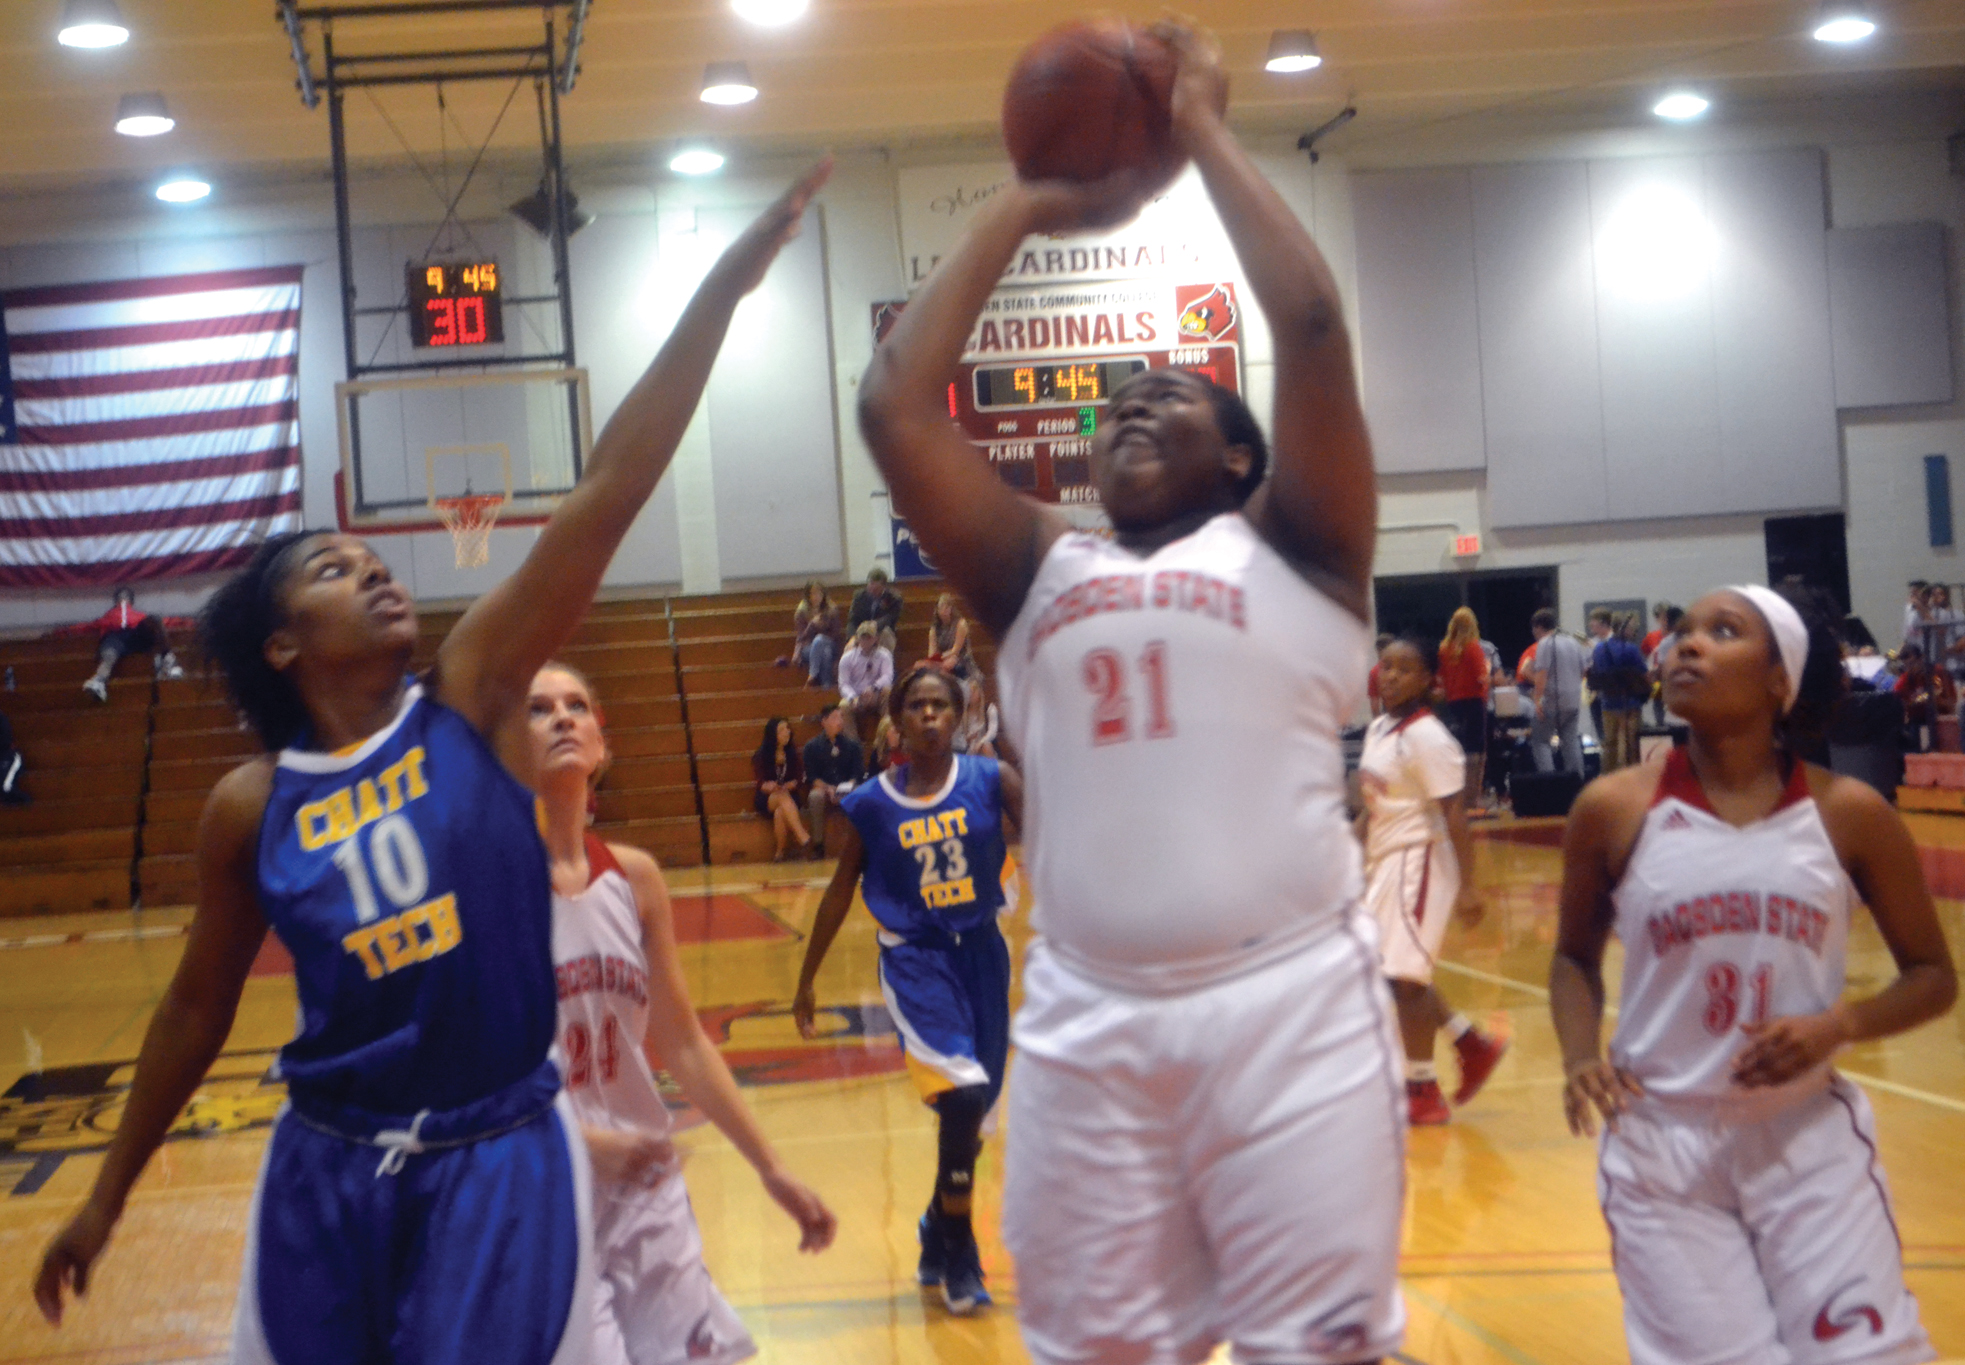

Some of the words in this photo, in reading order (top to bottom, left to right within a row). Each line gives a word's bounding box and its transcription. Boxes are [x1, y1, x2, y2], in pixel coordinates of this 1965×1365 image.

[426, 296, 487, 346] 30
[966, 311, 1157, 354] ARDINALS
[1168, 348, 1209, 366] BONUS
[1036, 418, 1077, 435] PERIOD
[1078, 406, 1096, 437] 3
[988, 442, 1036, 462] PLAYER
[1049, 439, 1093, 458] POINTS
[1151, 569, 1248, 633] STATE
[1081, 637, 1179, 748] 21
[295, 745, 428, 851] CHATT
[897, 806, 969, 849] CHATT
[332, 813, 430, 925] 10
[914, 838, 968, 888] 23
[920, 876, 976, 910] TECH
[341, 891, 463, 980] TECH
